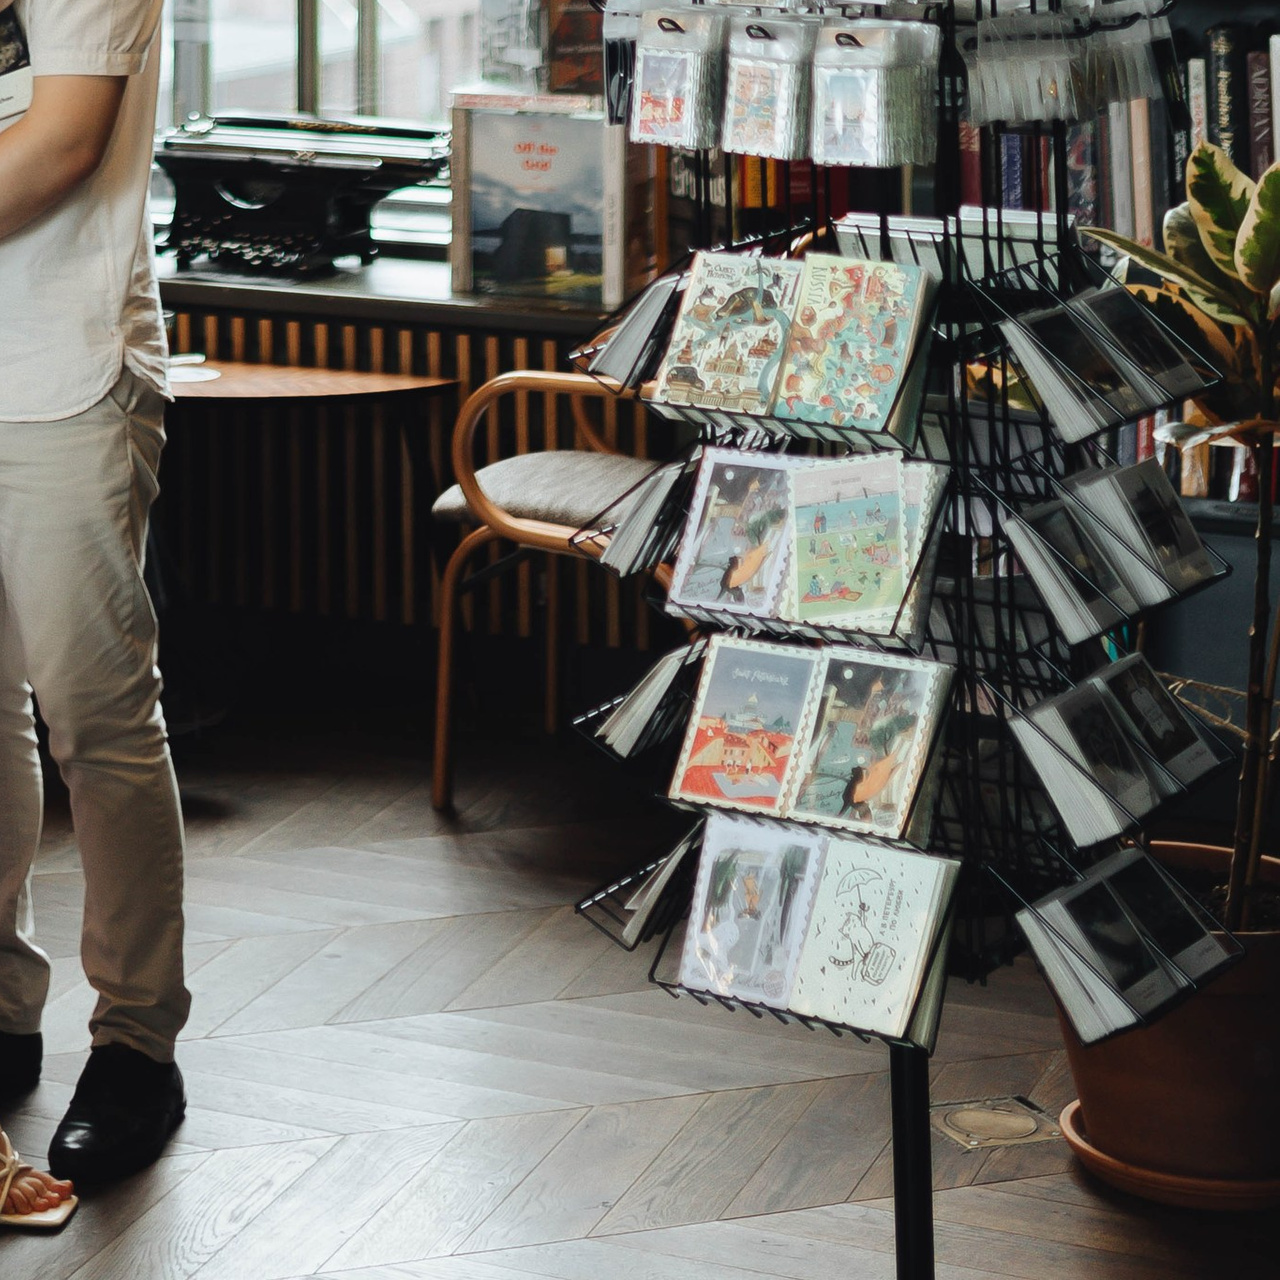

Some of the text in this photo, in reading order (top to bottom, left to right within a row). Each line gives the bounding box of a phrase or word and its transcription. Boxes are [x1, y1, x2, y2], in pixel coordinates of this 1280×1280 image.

[882, 878, 896, 921] ПЕТЕРБУРГ
[889, 889, 904, 931] ПО ЛЮБВИ
